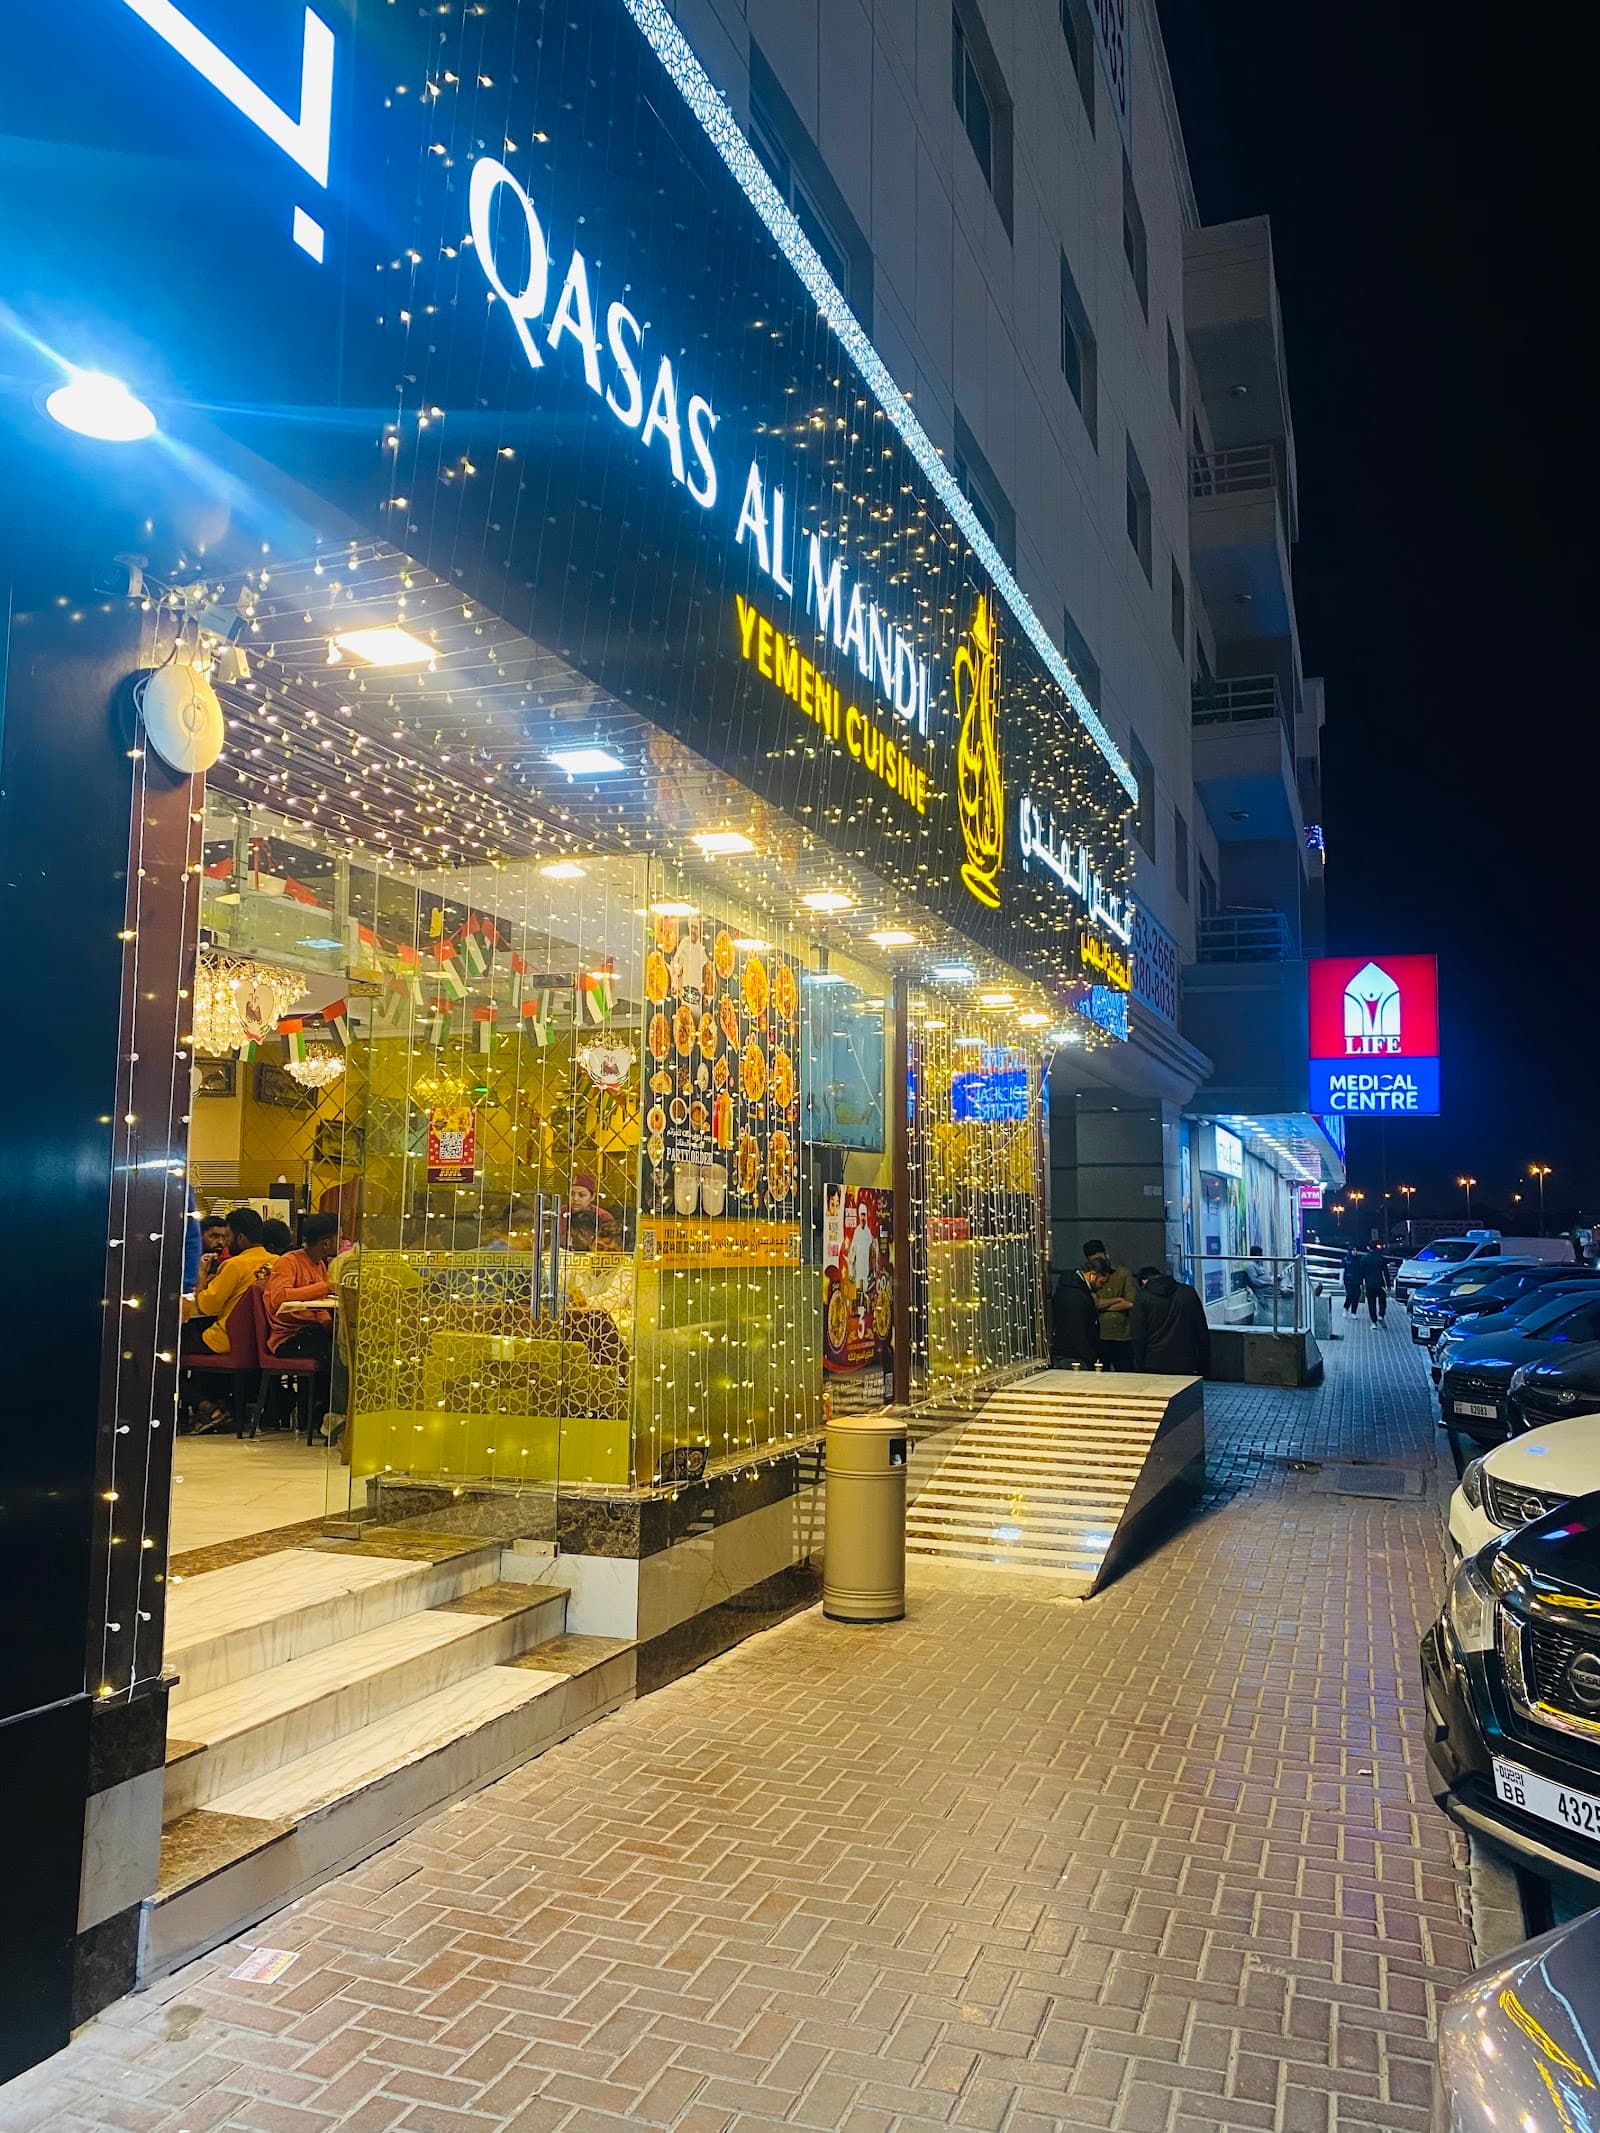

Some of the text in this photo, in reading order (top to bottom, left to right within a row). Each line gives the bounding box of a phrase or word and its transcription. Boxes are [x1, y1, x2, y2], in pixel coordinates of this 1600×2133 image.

[469, 156, 928, 738] QASAS AL MANDI
[735, 592, 928, 816] YEMENI CUISINE
[1130, 911, 1176, 983] 53-2666
[1344, 1036, 1402, 1055] LIFE
[1329, 1074, 1419, 1091] MEDICAL
[1329, 1091, 1419, 1110] CENTRE
[666, 1147, 690, 1162] PARTY
[1301, 1191, 1320, 1199] ATM
[1568, 1671, 1600, 1687] NISSA
[1503, 1781, 1526, 1806] BB
